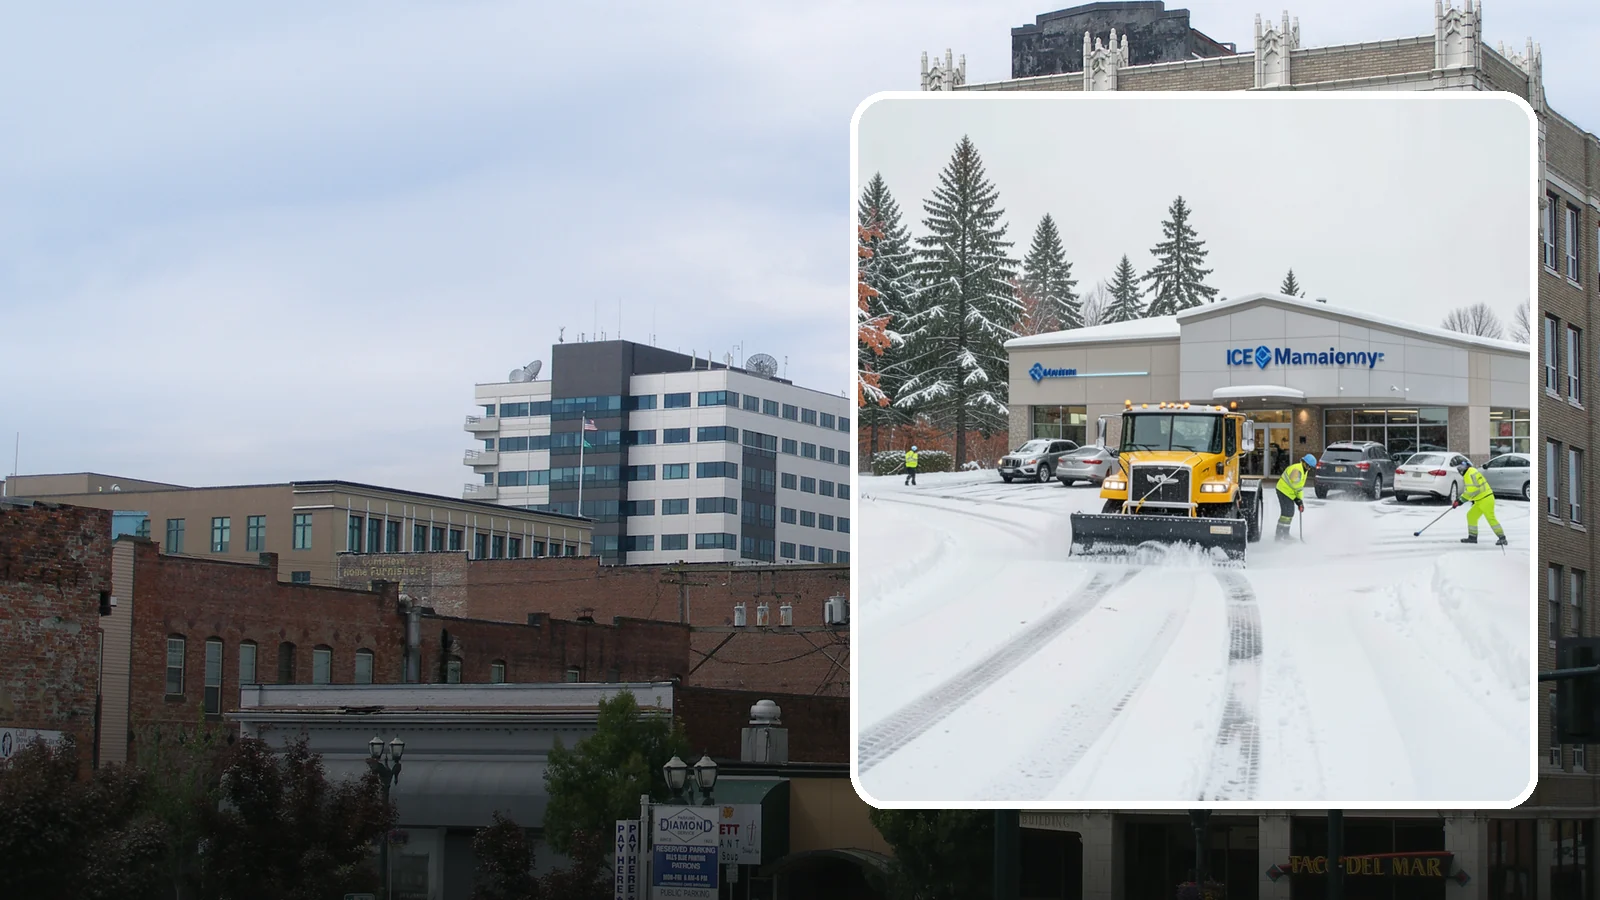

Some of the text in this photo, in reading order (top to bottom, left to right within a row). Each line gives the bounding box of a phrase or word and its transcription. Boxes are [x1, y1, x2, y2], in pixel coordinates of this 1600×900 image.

[1226, 348, 1253, 366] ICE
[370, 566, 427, 577] Furnishers
[660, 818, 713, 833] DIAMOND
[1022, 815, 1070, 828] BUILDING
[656, 845, 716, 854] RESERVED PARKING
[616, 825, 625, 894] PAY HERE
[627, 824, 637, 894] PAY HERE
[722, 851, 739, 862] Soup
[671, 862, 701, 870] PATRONS
[1289, 855, 1443, 877] TAC DEL MAR
[660, 888, 710, 898] PUBLIC PARKING
